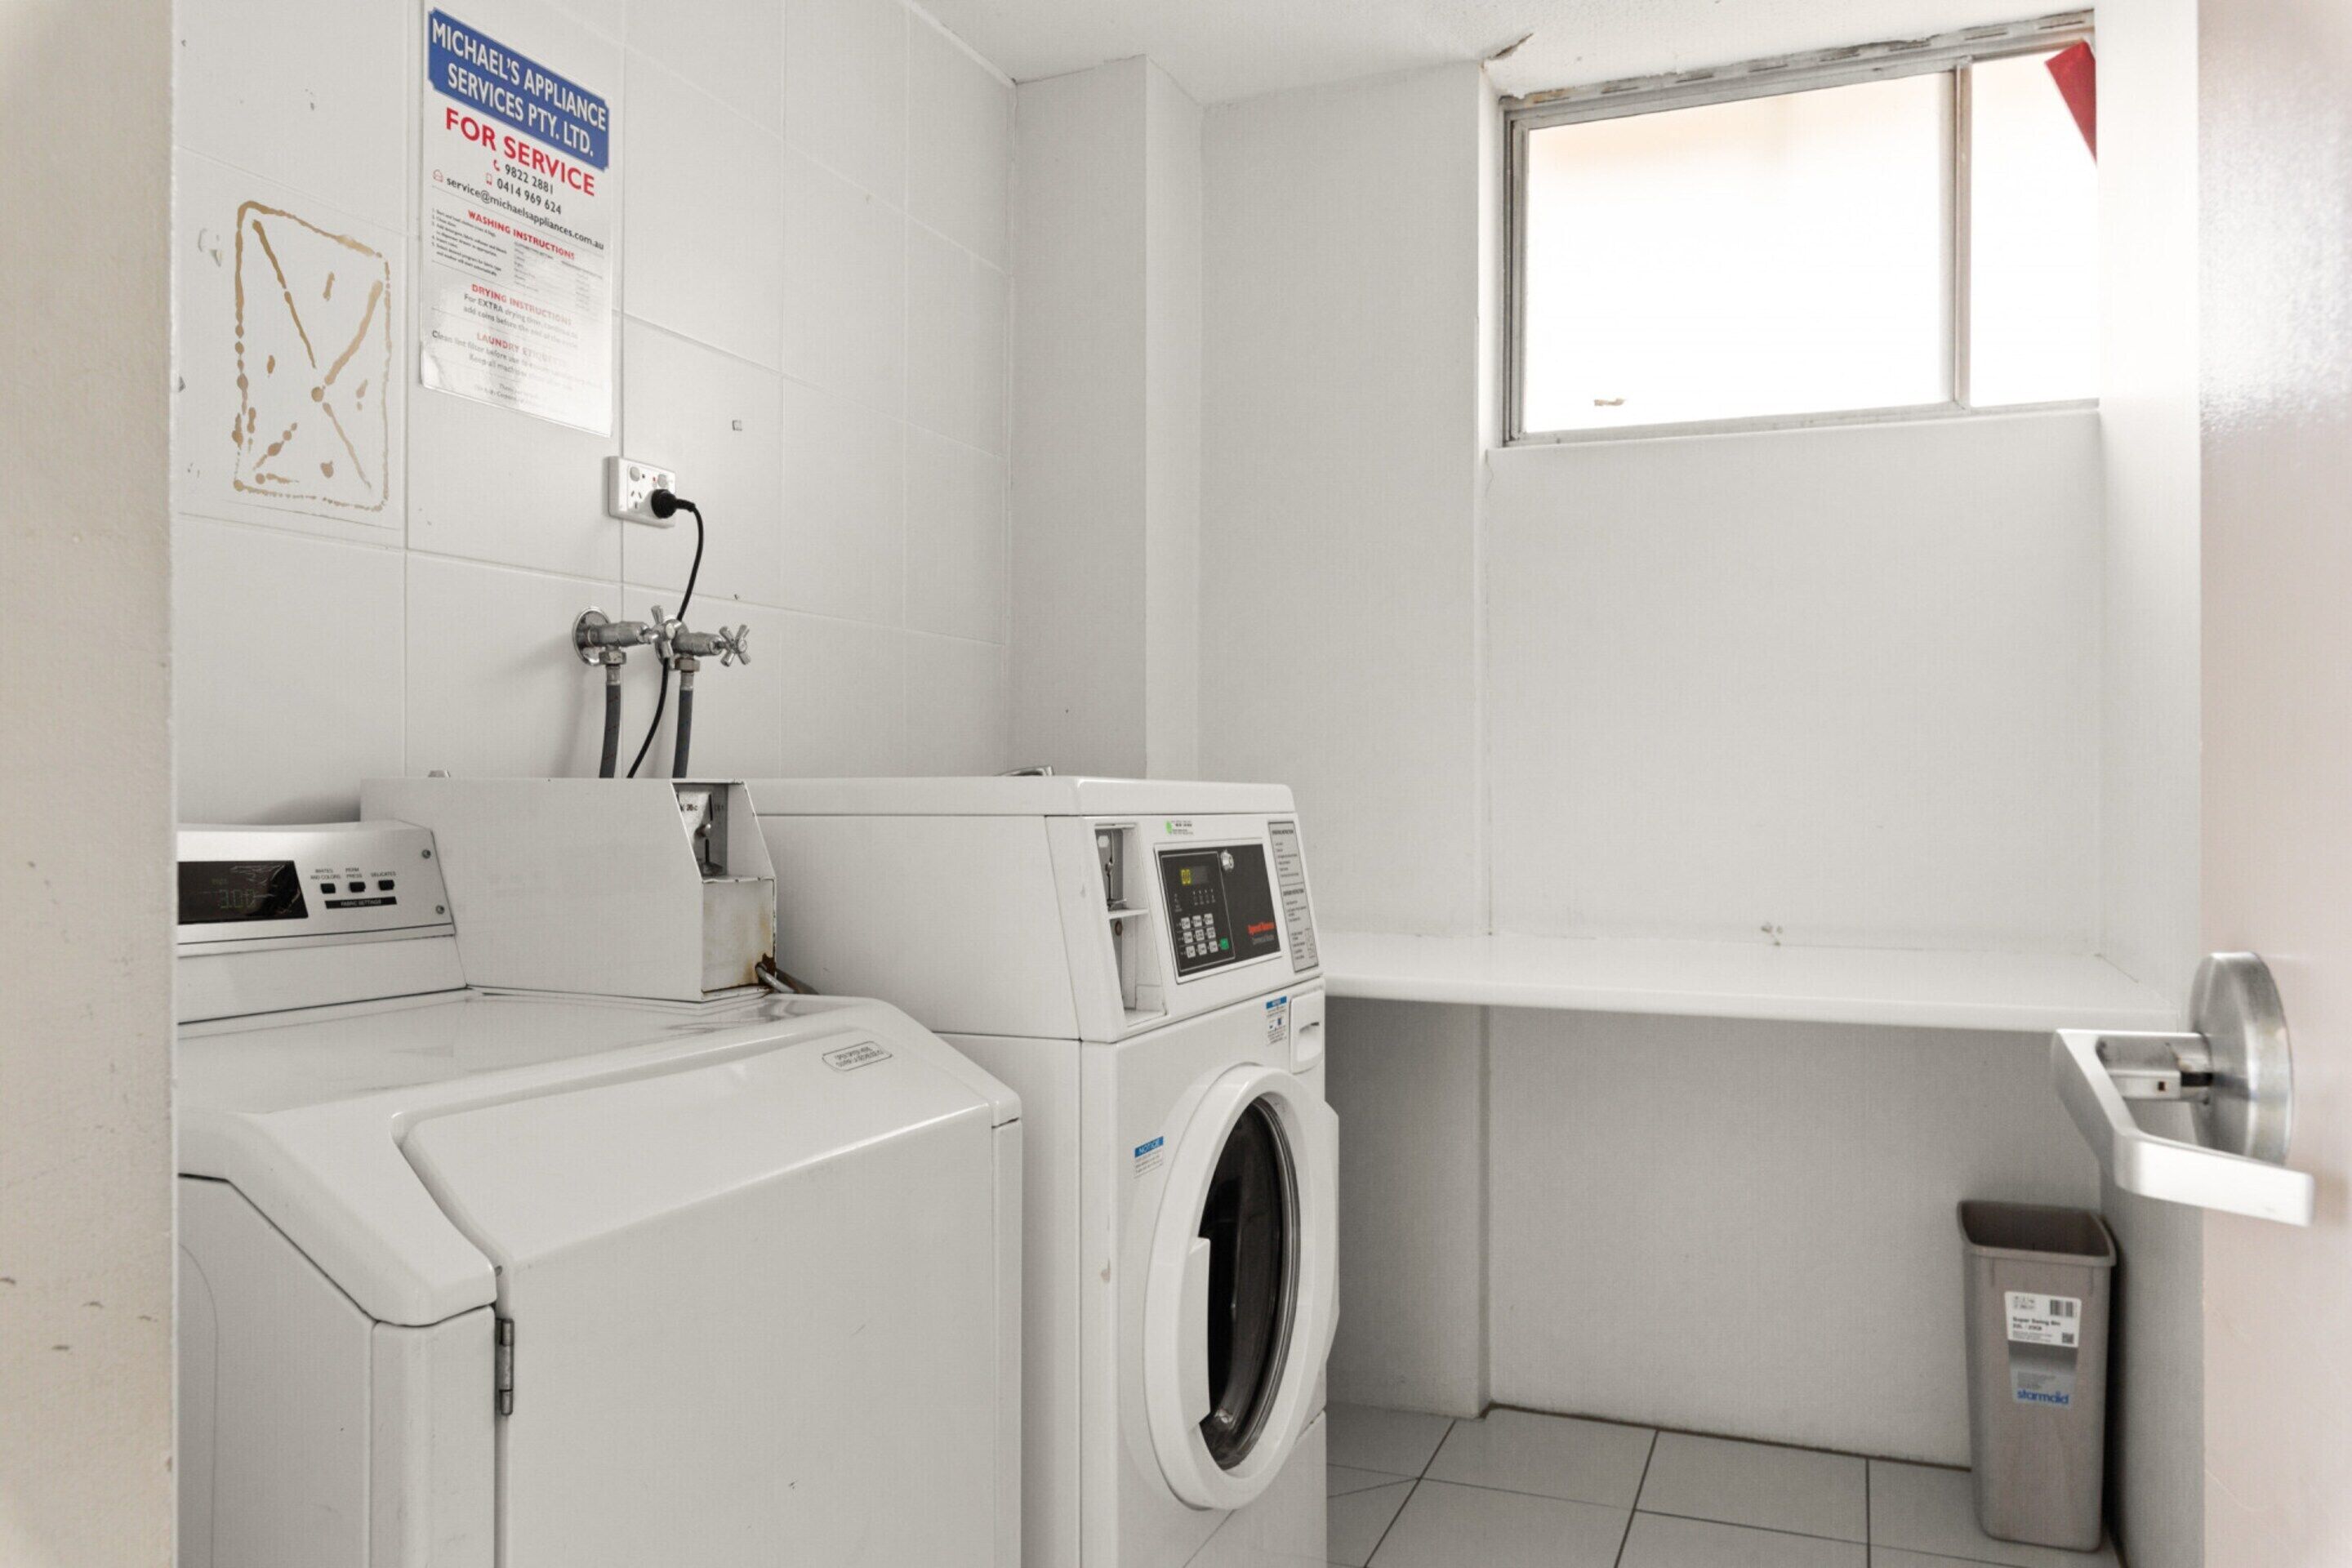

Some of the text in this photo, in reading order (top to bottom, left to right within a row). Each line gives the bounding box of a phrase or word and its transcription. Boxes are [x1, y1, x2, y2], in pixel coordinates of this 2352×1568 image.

[432, 17, 606, 131] MICHAEL'S APPLIANCE
[448, 62, 594, 157] SERVICES PTY. LTD.
[446, 107, 595, 197] FOR SERVICE
[497, 178, 561, 215] 0414 969 624
[505, 163, 554, 194] 9822 2881
[446, 178, 604, 250] service@michaelsappliances.com.au
[467, 209, 510, 234] WASHING
[514, 229, 575, 261] INSTRUCTIONS
[471, 283, 507, 302] DRYING
[478, 298, 503, 313] EXTRA
[477, 332, 519, 353] LAUNDRY
[2016, 1389, 2069, 1405] starmaid
